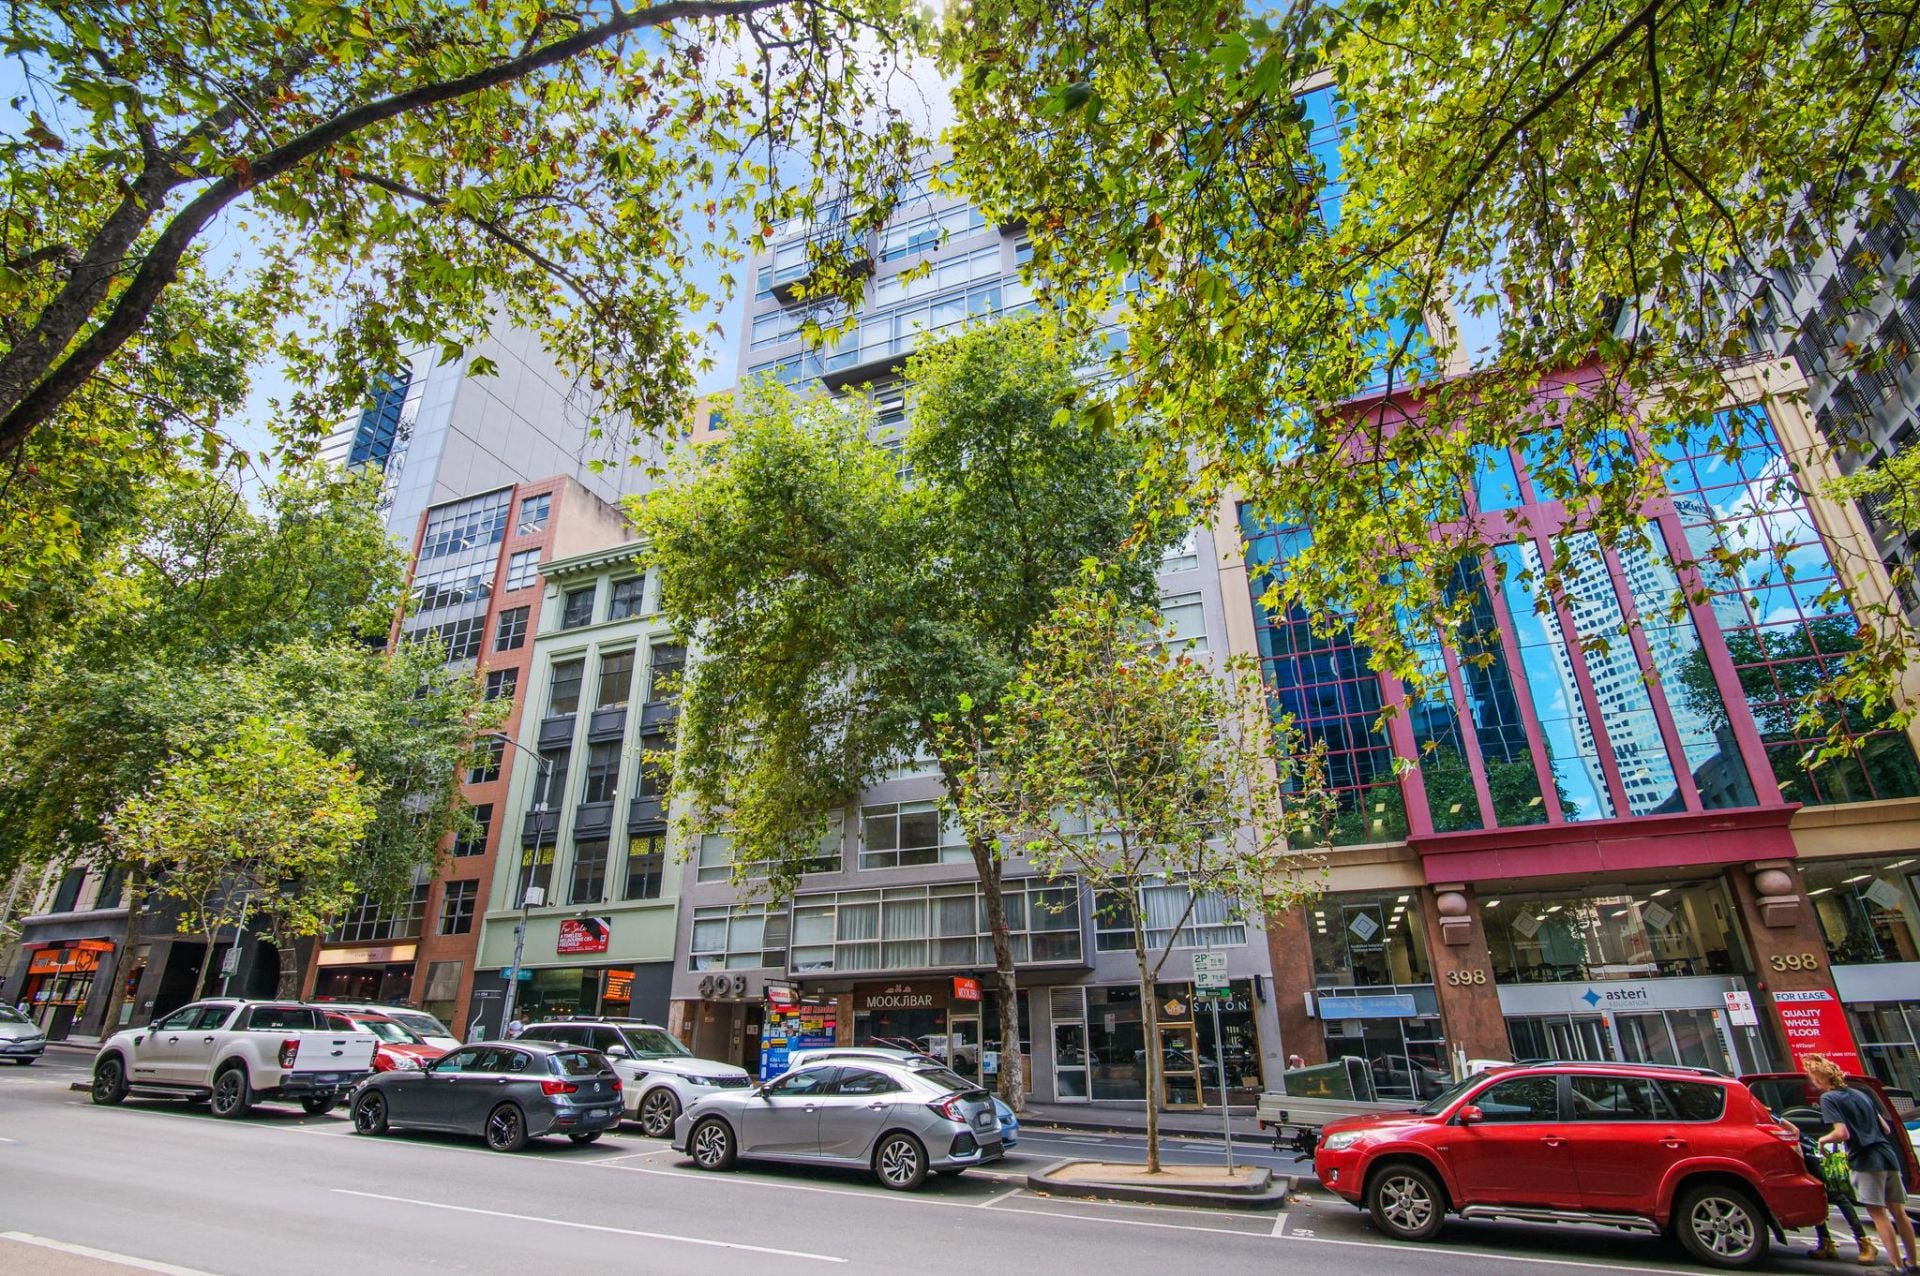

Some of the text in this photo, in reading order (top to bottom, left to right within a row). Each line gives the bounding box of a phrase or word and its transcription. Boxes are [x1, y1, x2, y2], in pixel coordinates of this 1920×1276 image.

[1194, 954, 1207, 962] 2P
[1770, 953, 1818, 972] 398
[1198, 974, 1207, 982] 1P
[1447, 969, 1486, 985] 398
[698, 973, 746, 997] 408
[1606, 987, 1647, 1000] asteri
[1798, 992, 1826, 1000] LEASE
[866, 994, 932, 1008] MOOKJIBAR
[1193, 1000, 1247, 1012] SALON
[1782, 1009, 1821, 1018] QUALITY
[1785, 1019, 1820, 1027] WHOLE
[1788, 1028, 1820, 1037] FLOOR
